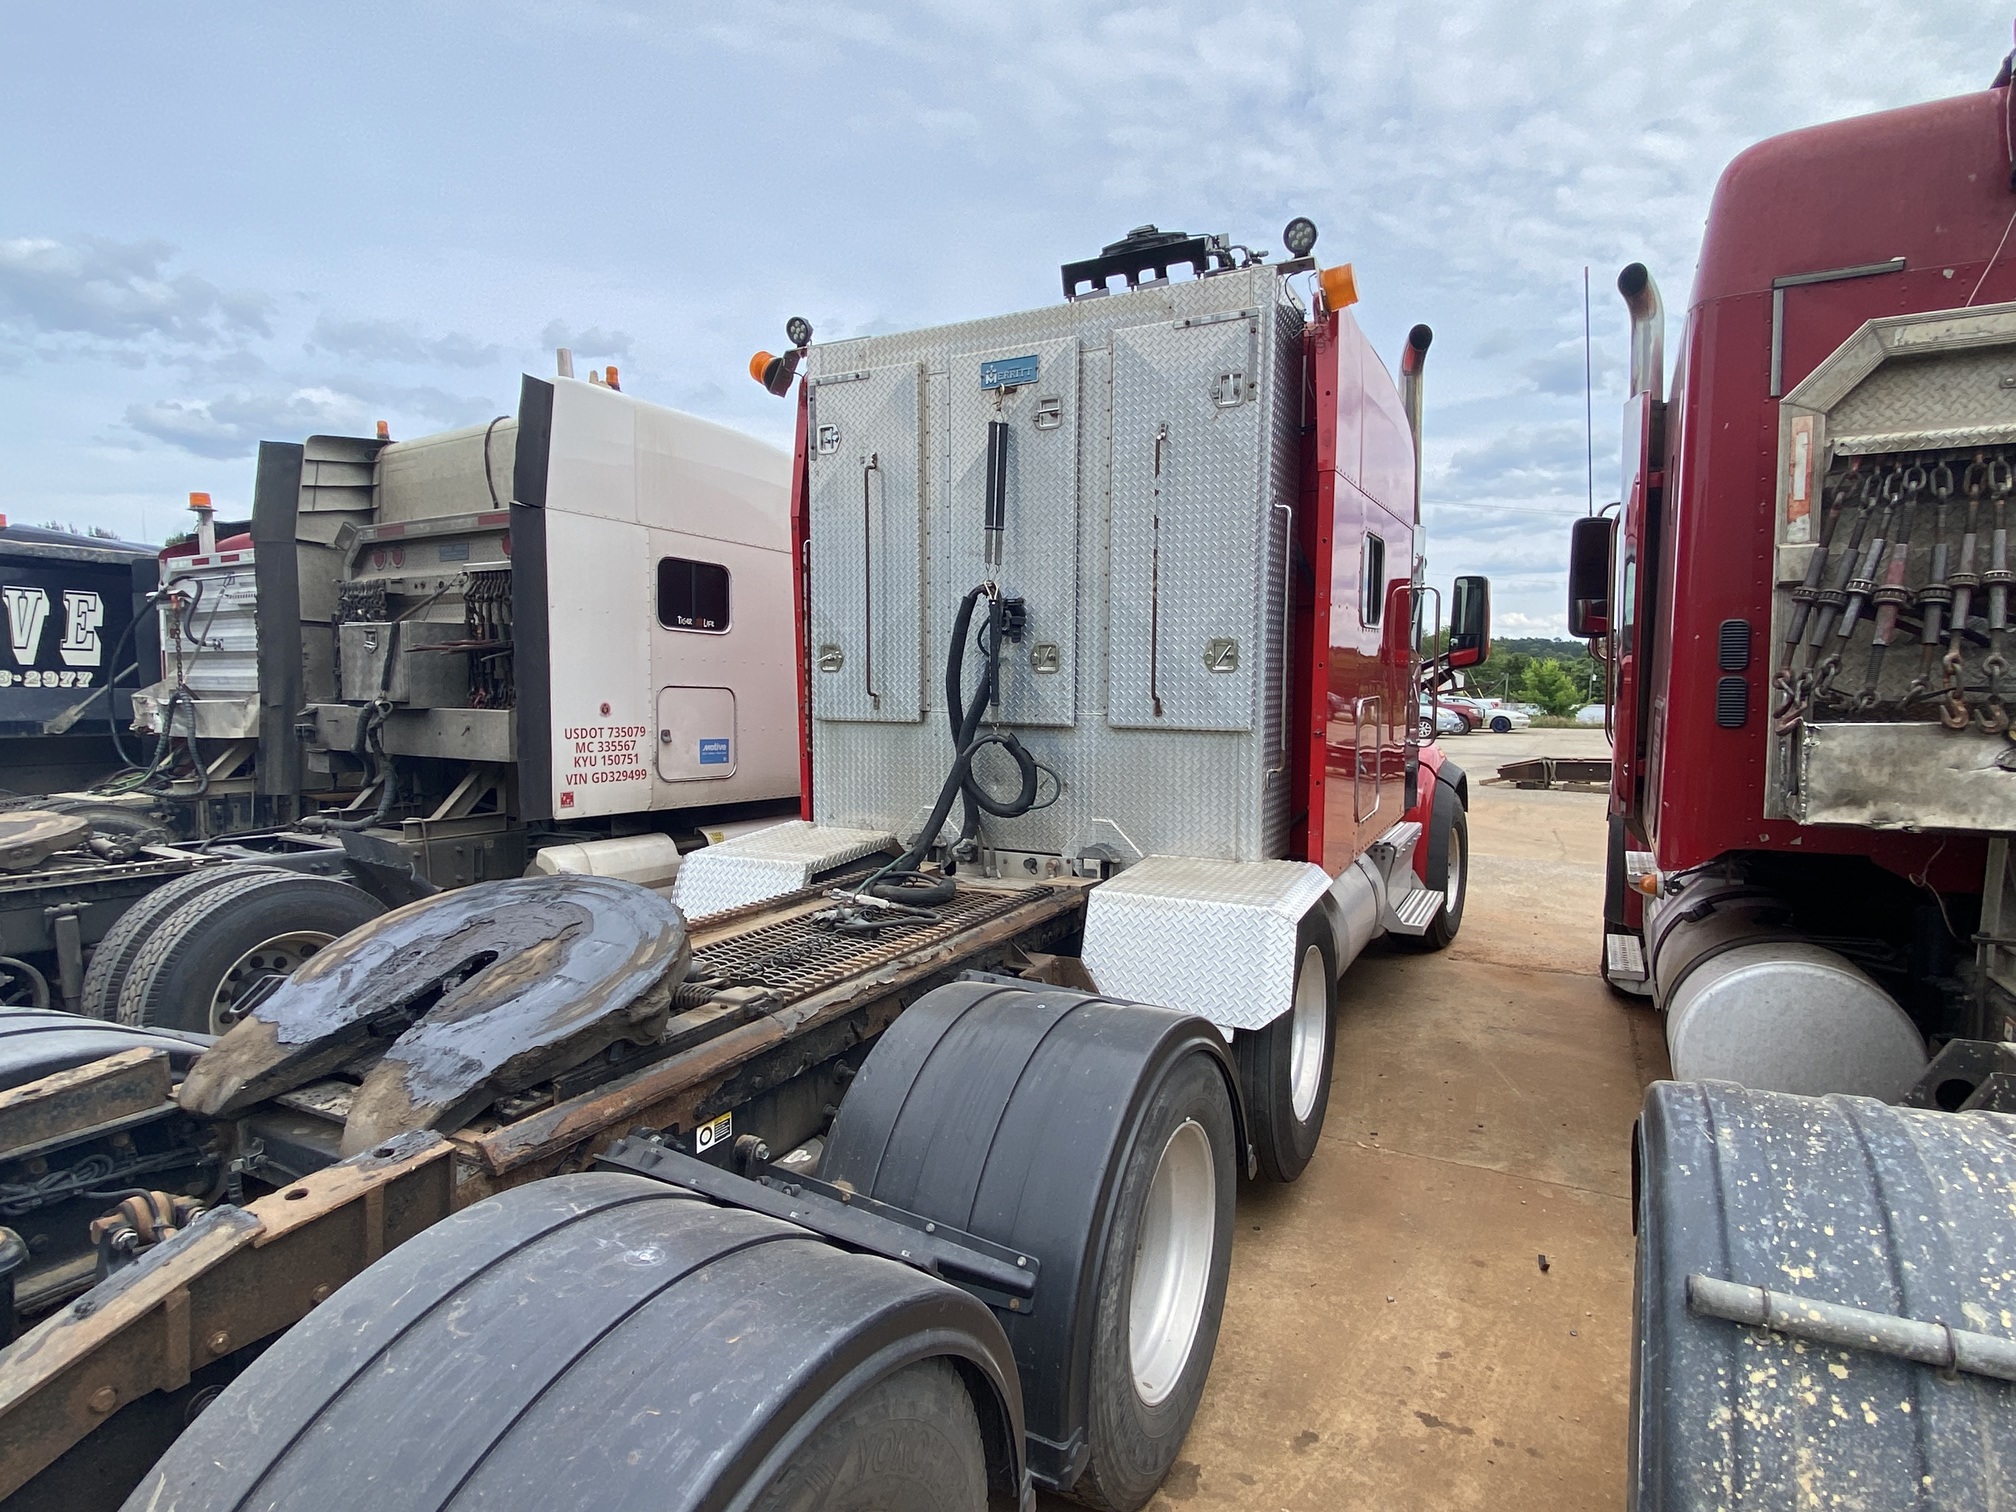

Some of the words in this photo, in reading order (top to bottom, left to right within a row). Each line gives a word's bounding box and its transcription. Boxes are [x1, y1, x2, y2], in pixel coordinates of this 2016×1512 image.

[985, 367, 1032, 385] MERRITT
[564, 727, 605, 740] USDOT
[607, 726, 646, 738] 735079
[575, 741, 594, 754] MC
[597, 740, 637, 753] 335567
[574, 755, 597, 768] KYU
[600, 753, 639, 766] 150751
[565, 773, 588, 786] VIN
[591, 769, 647, 783] GD329499
